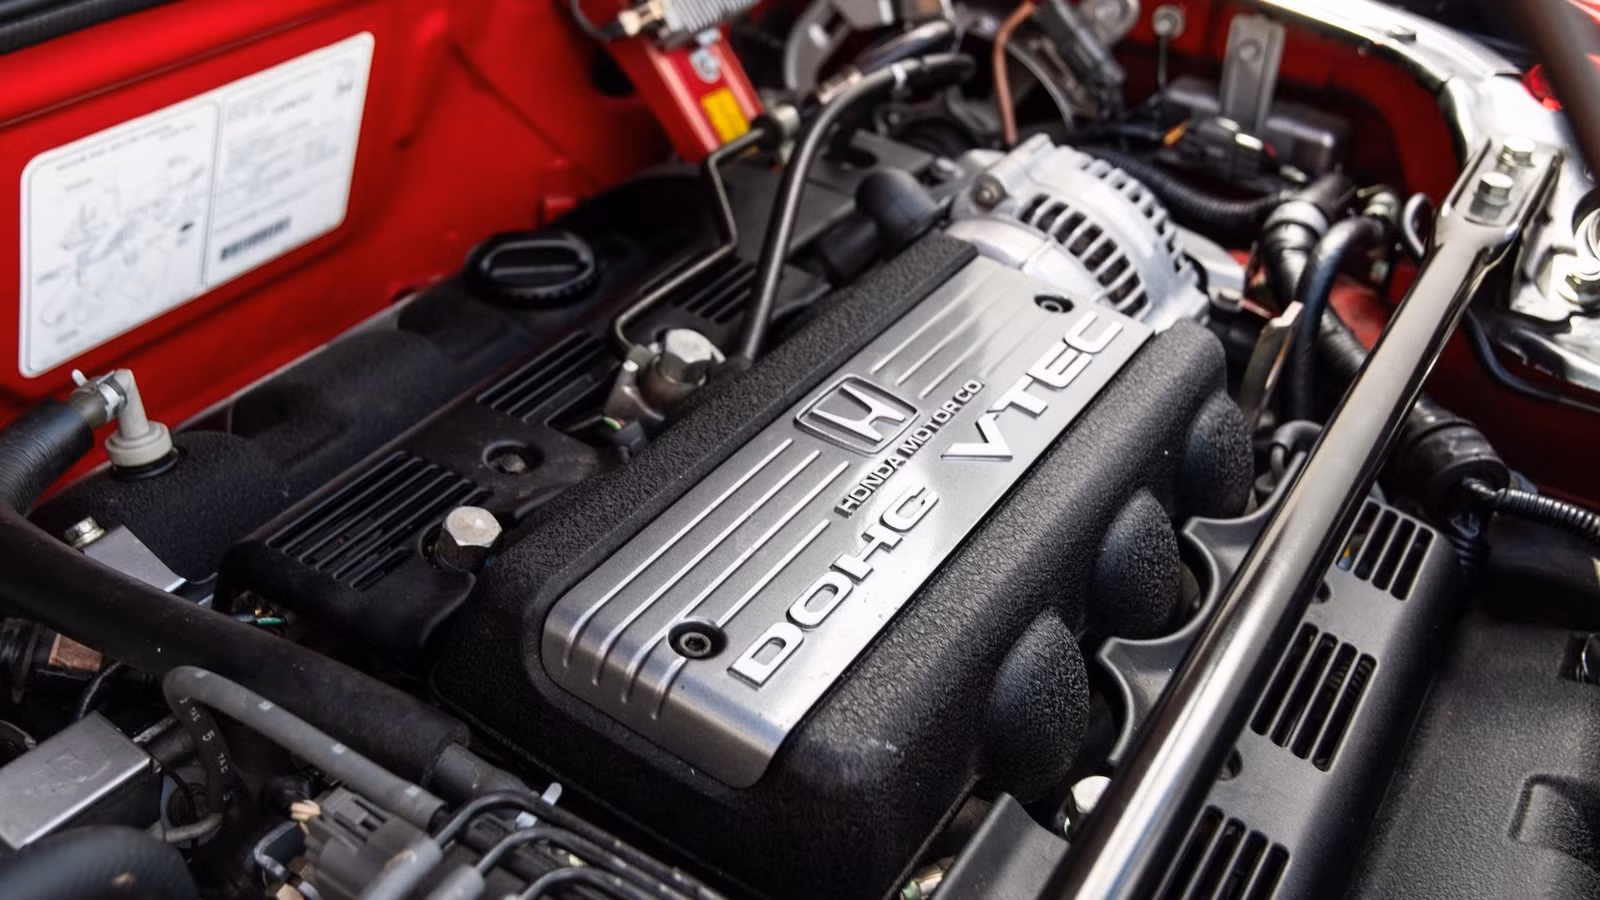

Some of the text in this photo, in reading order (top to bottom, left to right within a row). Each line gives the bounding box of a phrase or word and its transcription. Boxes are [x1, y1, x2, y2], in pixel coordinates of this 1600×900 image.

[727, 311, 1124, 690] DOHC VTEC
[835, 454, 906, 518] HONDA
[897, 402, 961, 460] MOTOR
